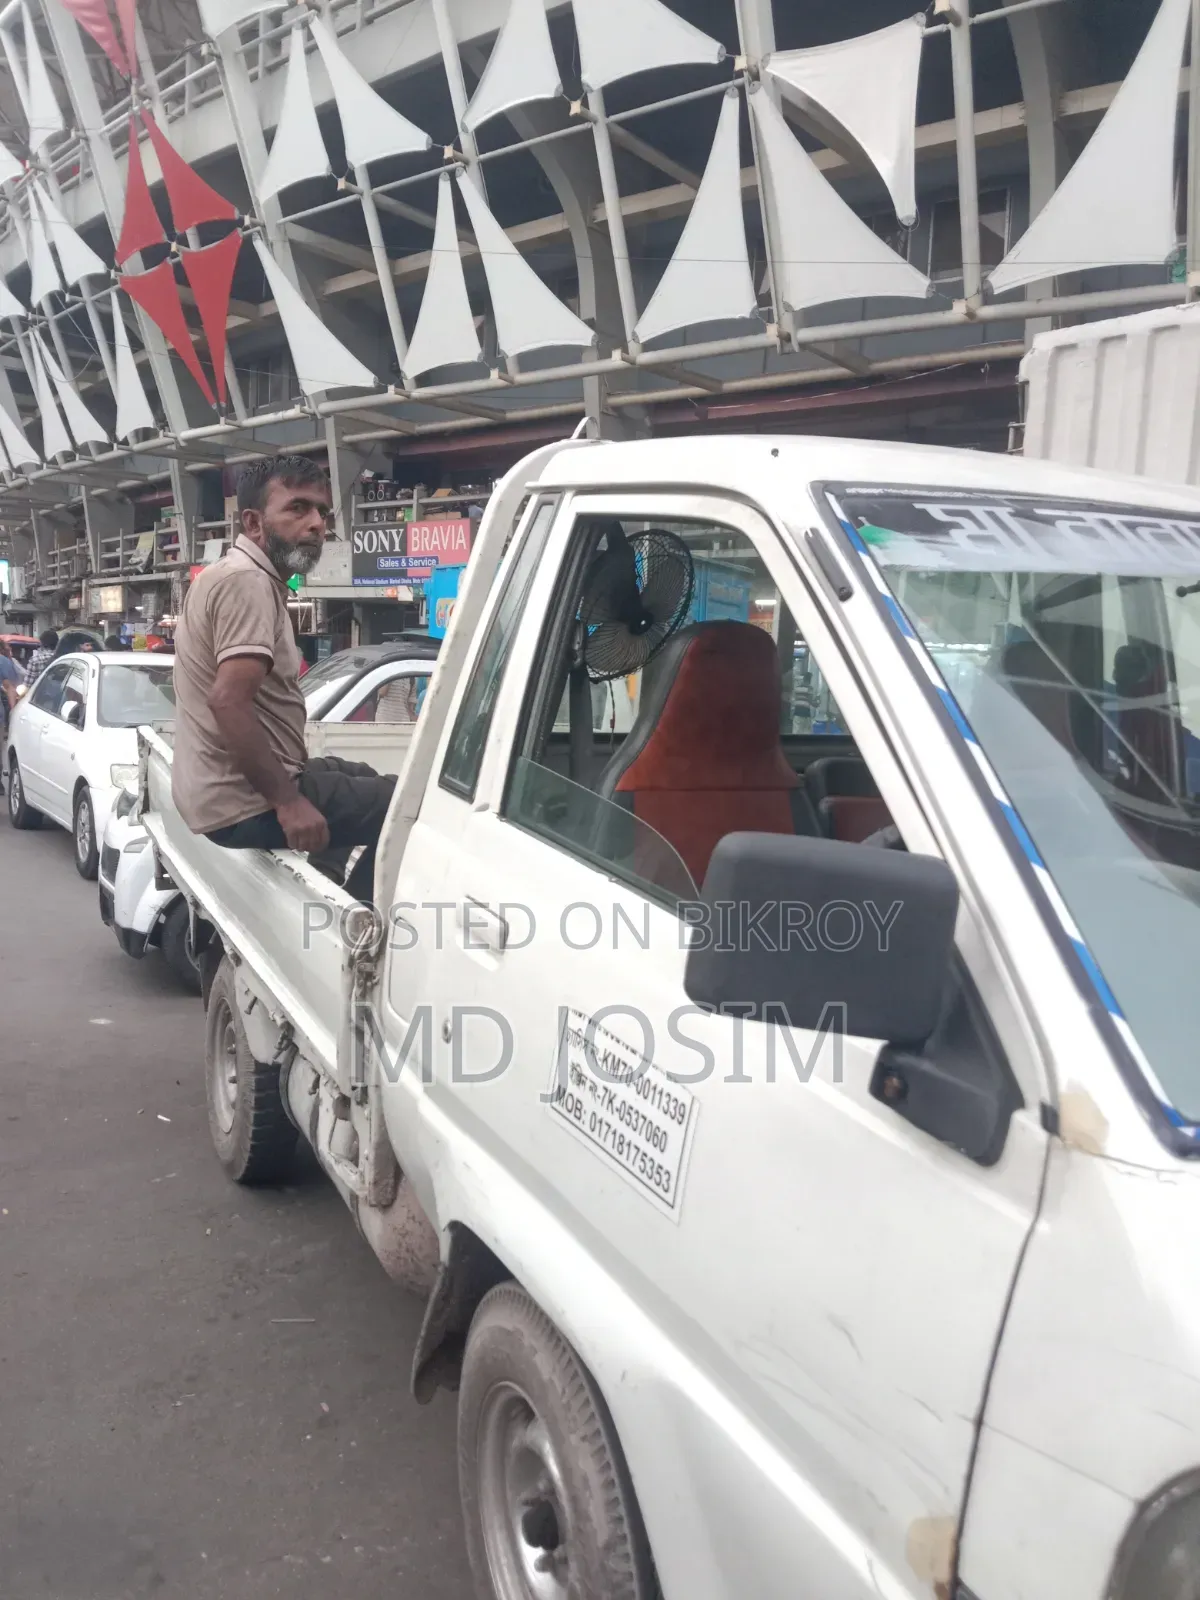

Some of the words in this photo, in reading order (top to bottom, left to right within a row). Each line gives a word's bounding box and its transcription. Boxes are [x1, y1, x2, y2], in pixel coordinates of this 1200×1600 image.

[353, 528, 404, 554] SONY
[411, 525, 467, 552] BRAVIA
[379, 558, 399, 568] Sales
[401, 557, 407, 567] &
[408, 556, 437, 567] Service
[555, 1085, 588, 1125] MOB:
[589, 1114, 672, 1194] 01718175353
